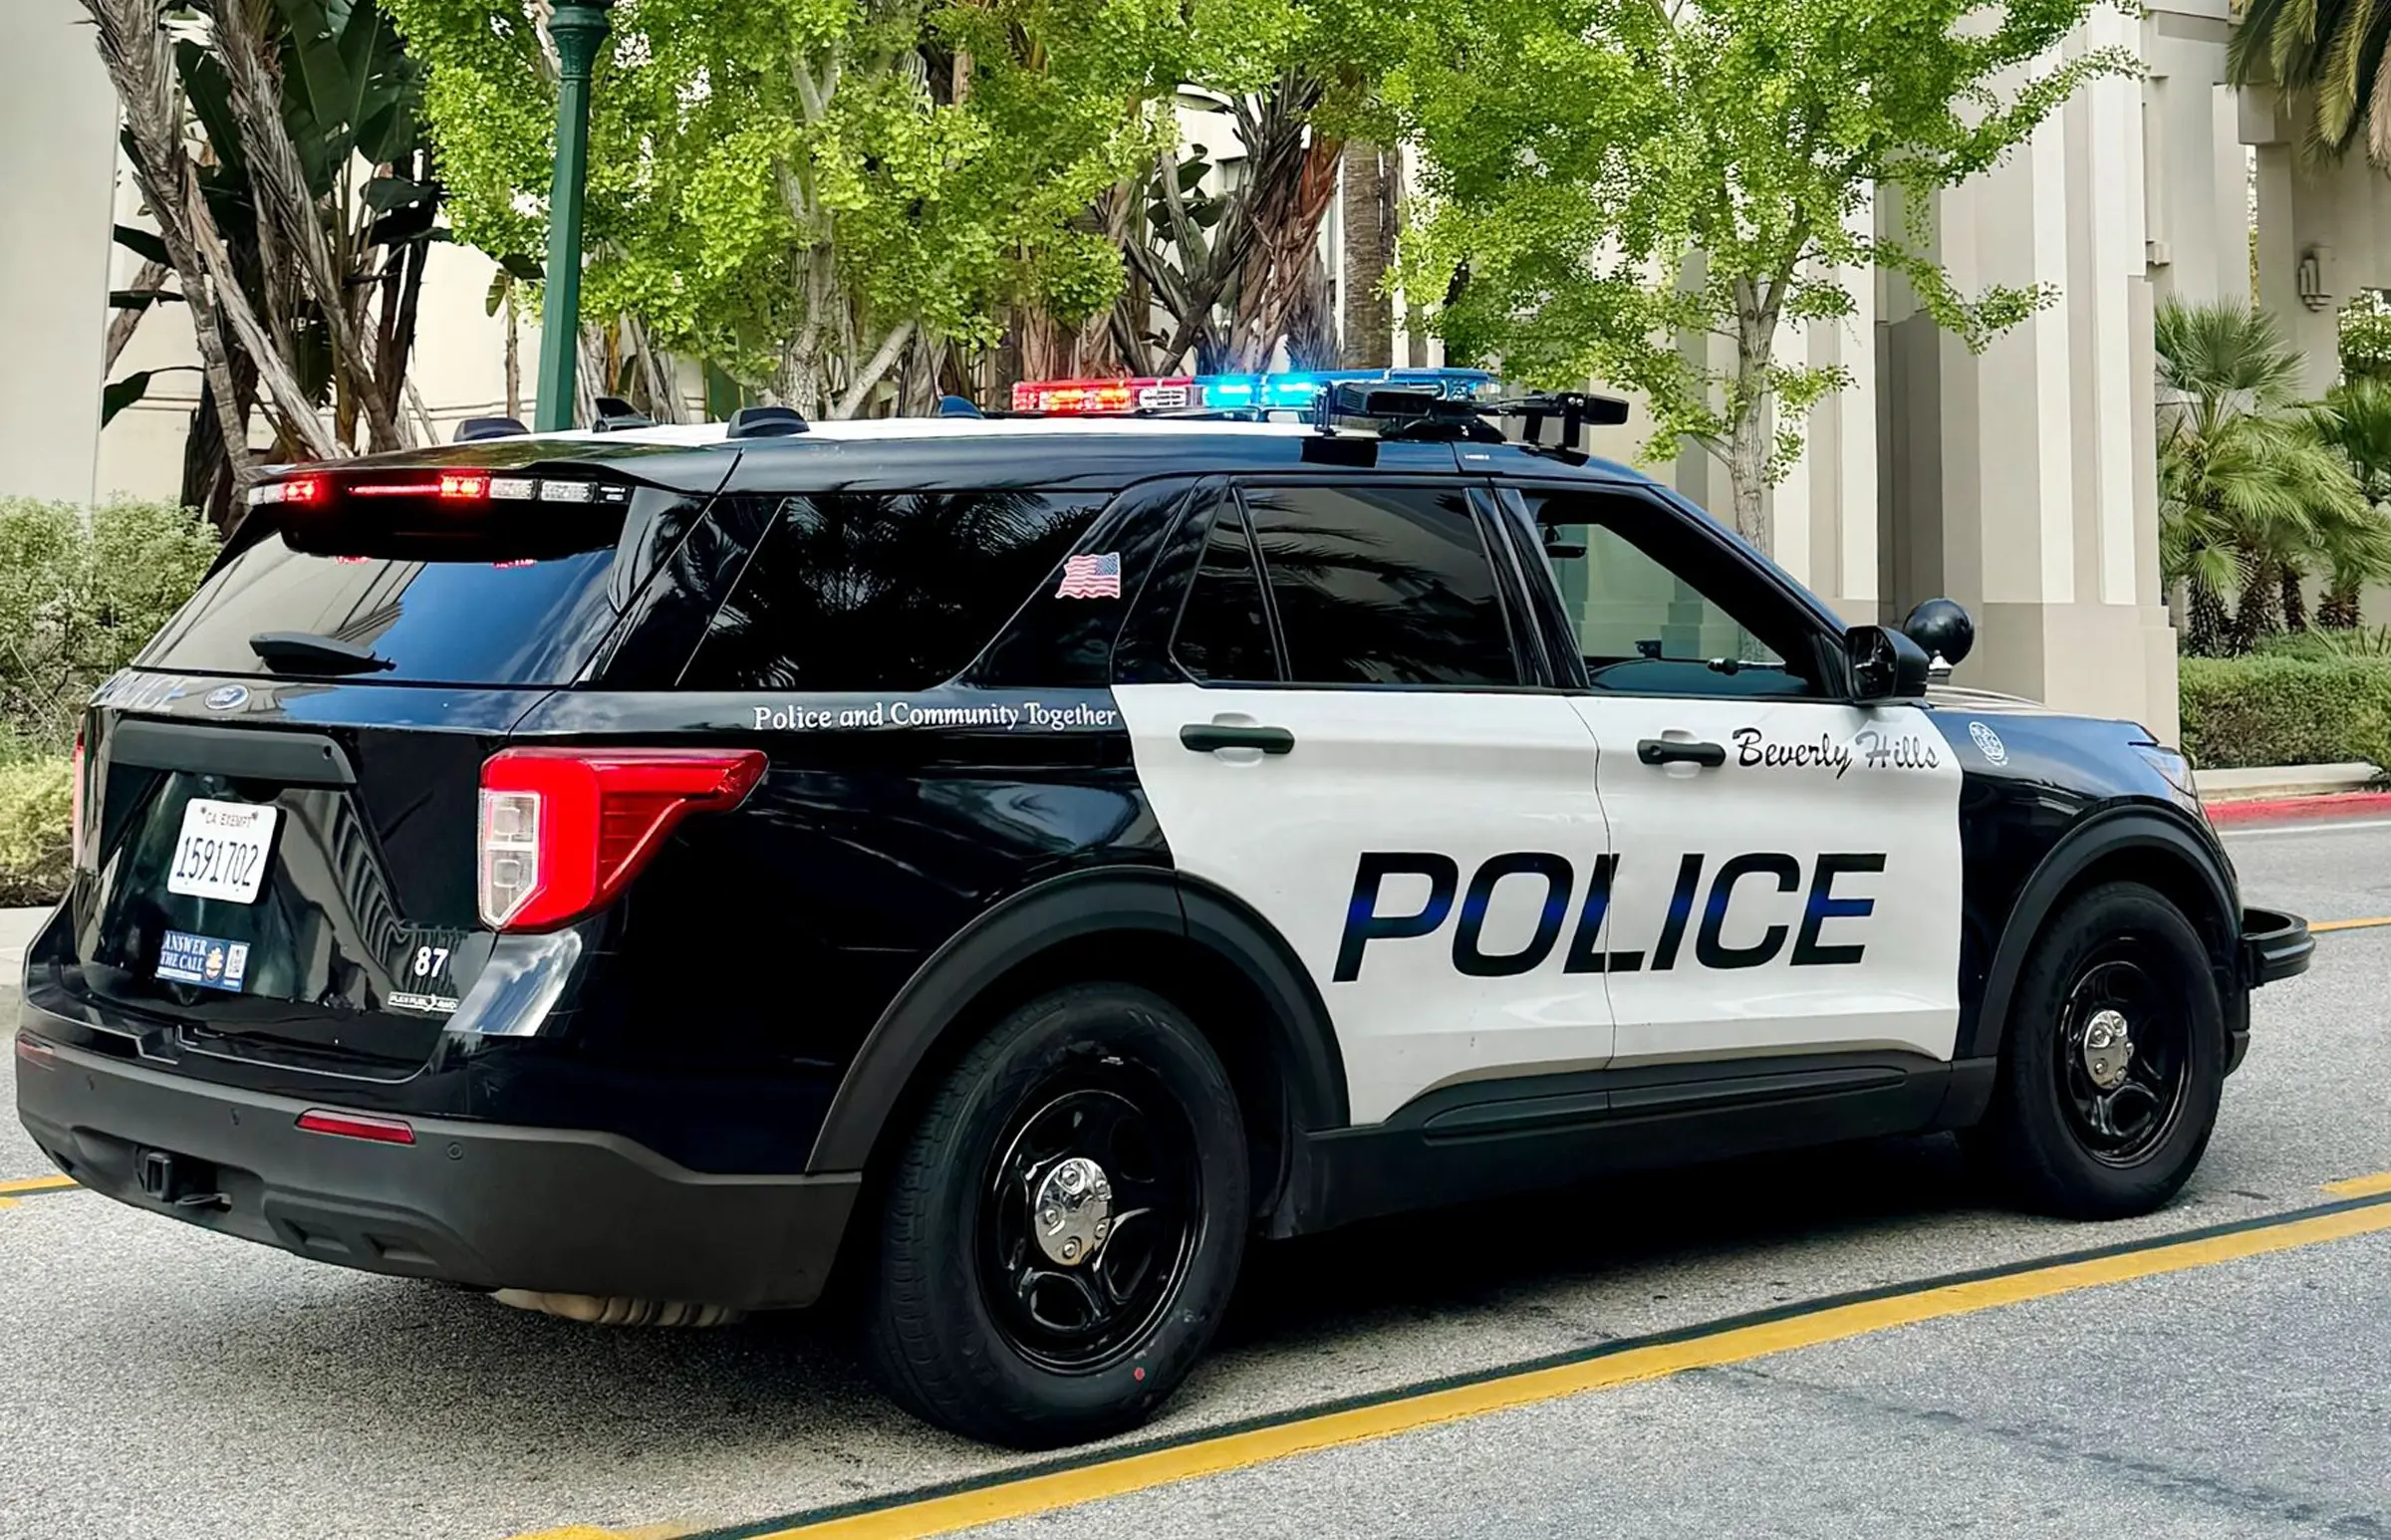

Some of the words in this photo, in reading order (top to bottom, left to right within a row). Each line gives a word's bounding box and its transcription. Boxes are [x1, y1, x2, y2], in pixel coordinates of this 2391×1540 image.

[753, 705, 833, 730] Police
[839, 702, 884, 727] and
[890, 702, 1019, 730] Community
[1023, 702, 1117, 731] Together
[1731, 727, 1852, 779] Beverly
[1854, 730, 1941, 769] Hills
[176, 837, 259, 887] 1591702
[1332, 852, 1887, 982] POLICE
[160, 950, 179, 967] THE
[179, 955, 205, 972] CALL
[161, 934, 208, 956] ANSWER
[414, 945, 449, 978] 87
